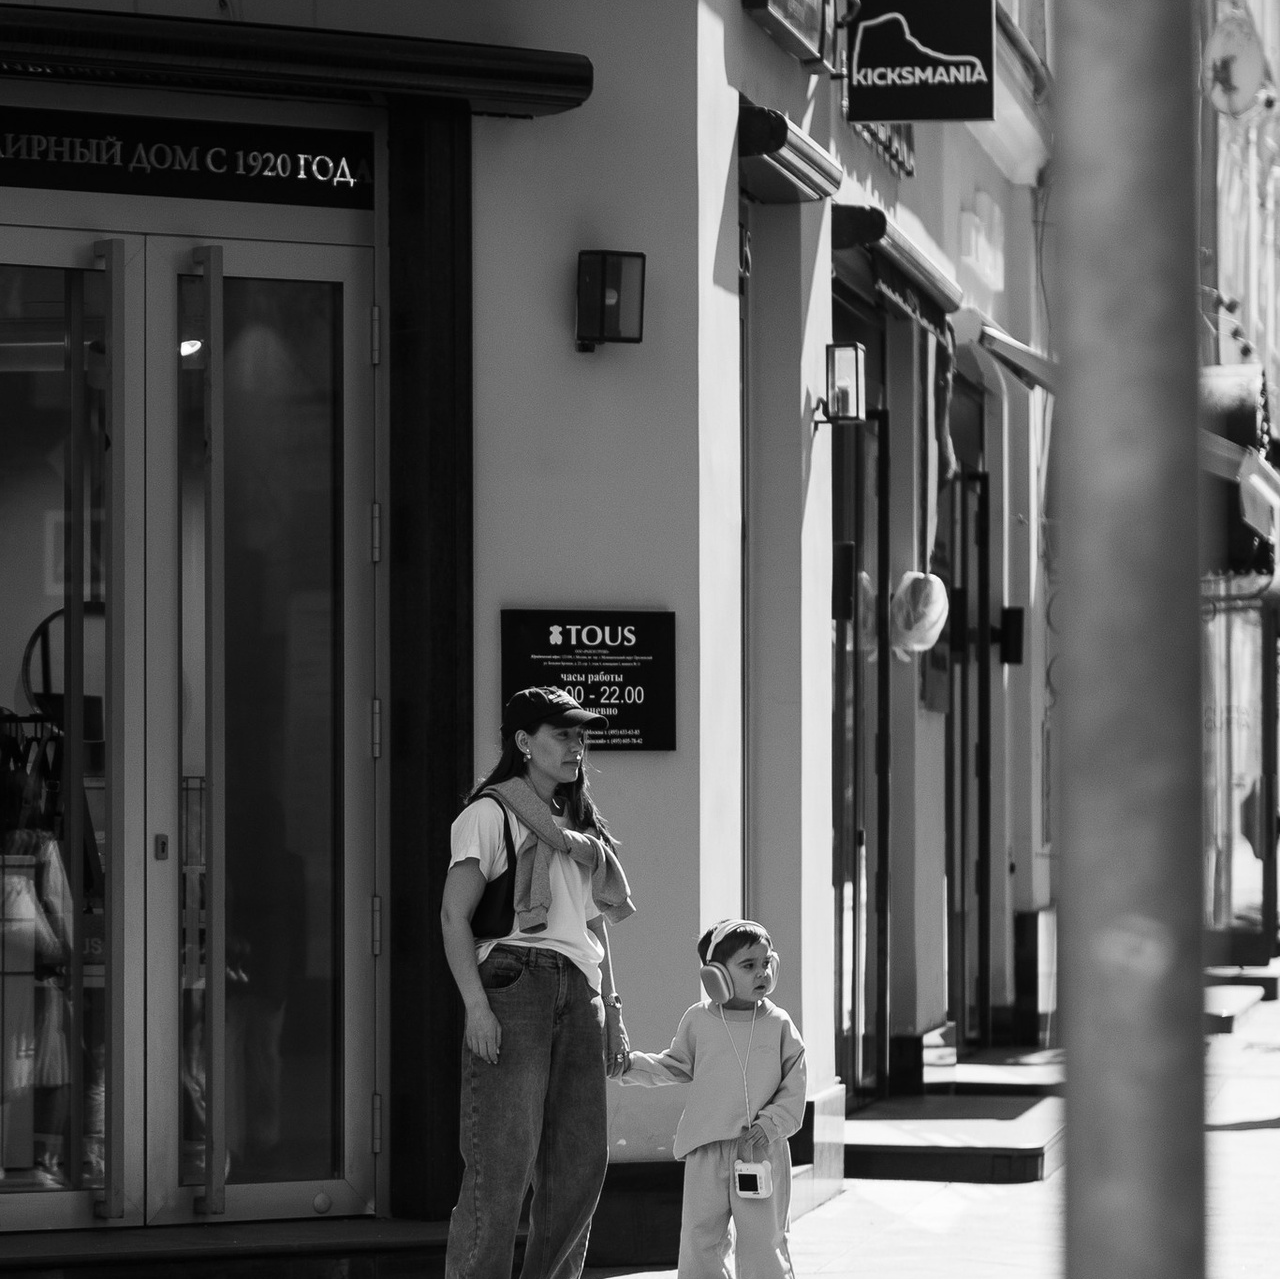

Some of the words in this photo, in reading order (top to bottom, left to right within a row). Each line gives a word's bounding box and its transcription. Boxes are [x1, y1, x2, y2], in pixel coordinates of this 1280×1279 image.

[853, 64, 988, 86] KICKSMANIA
[127, 142, 200, 174] ДОМ
[234, 150, 291, 179] 1920
[566, 625, 636, 646] TOUS
[560, 673, 585, 682] часы
[588, 671, 624, 684] работы
[600, 685, 645, 704] 22.00
